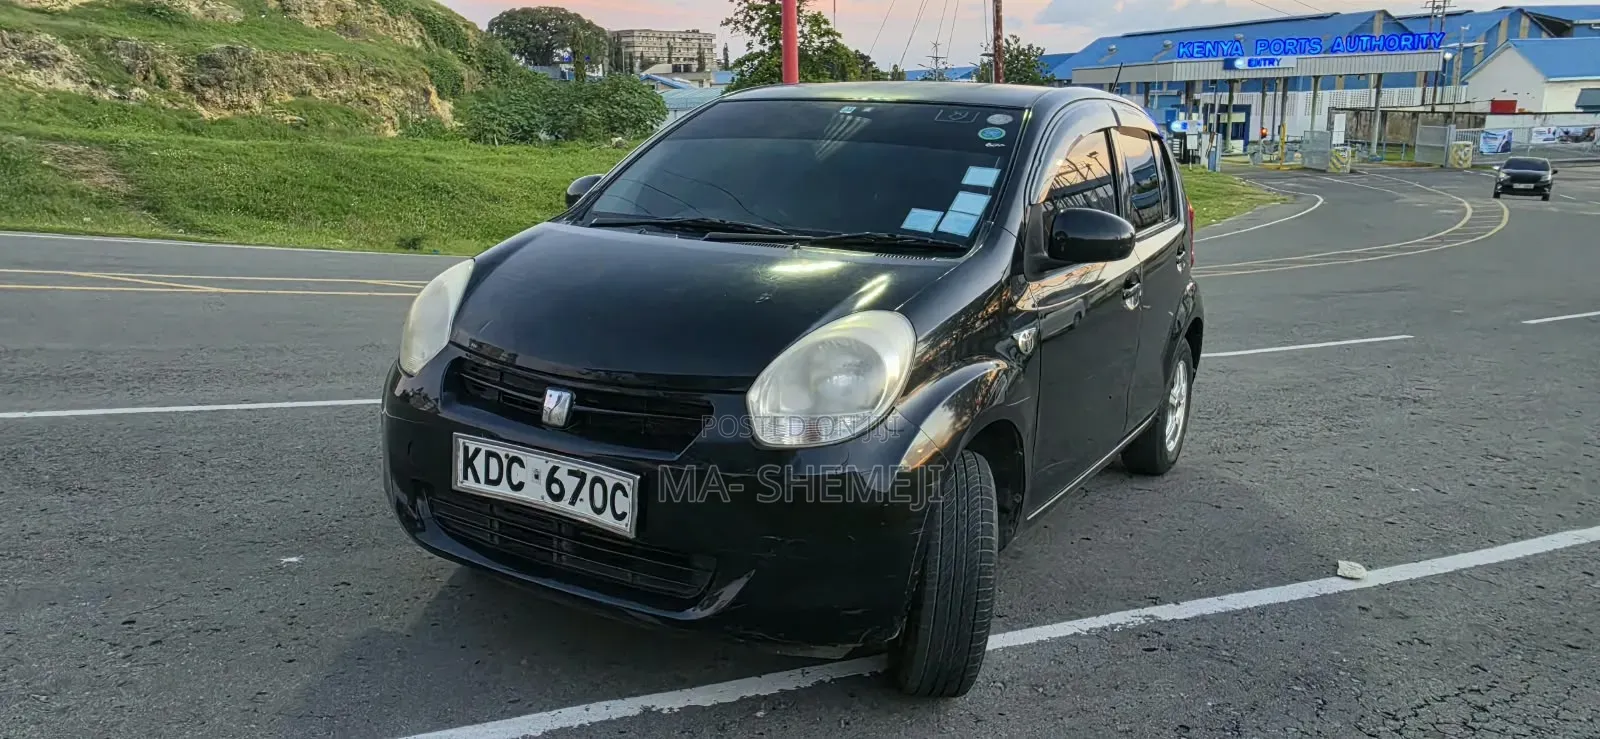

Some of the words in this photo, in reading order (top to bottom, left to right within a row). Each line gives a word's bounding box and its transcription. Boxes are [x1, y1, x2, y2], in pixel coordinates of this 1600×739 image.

[1177, 40, 1244, 58] KENYA
[1256, 37, 1323, 56] PORTS
[1330, 31, 1446, 54] AUTHORITY
[1247, 57, 1282, 68] ENTRY
[462, 445, 526, 492] KDC
[545, 464, 630, 522] 670C
